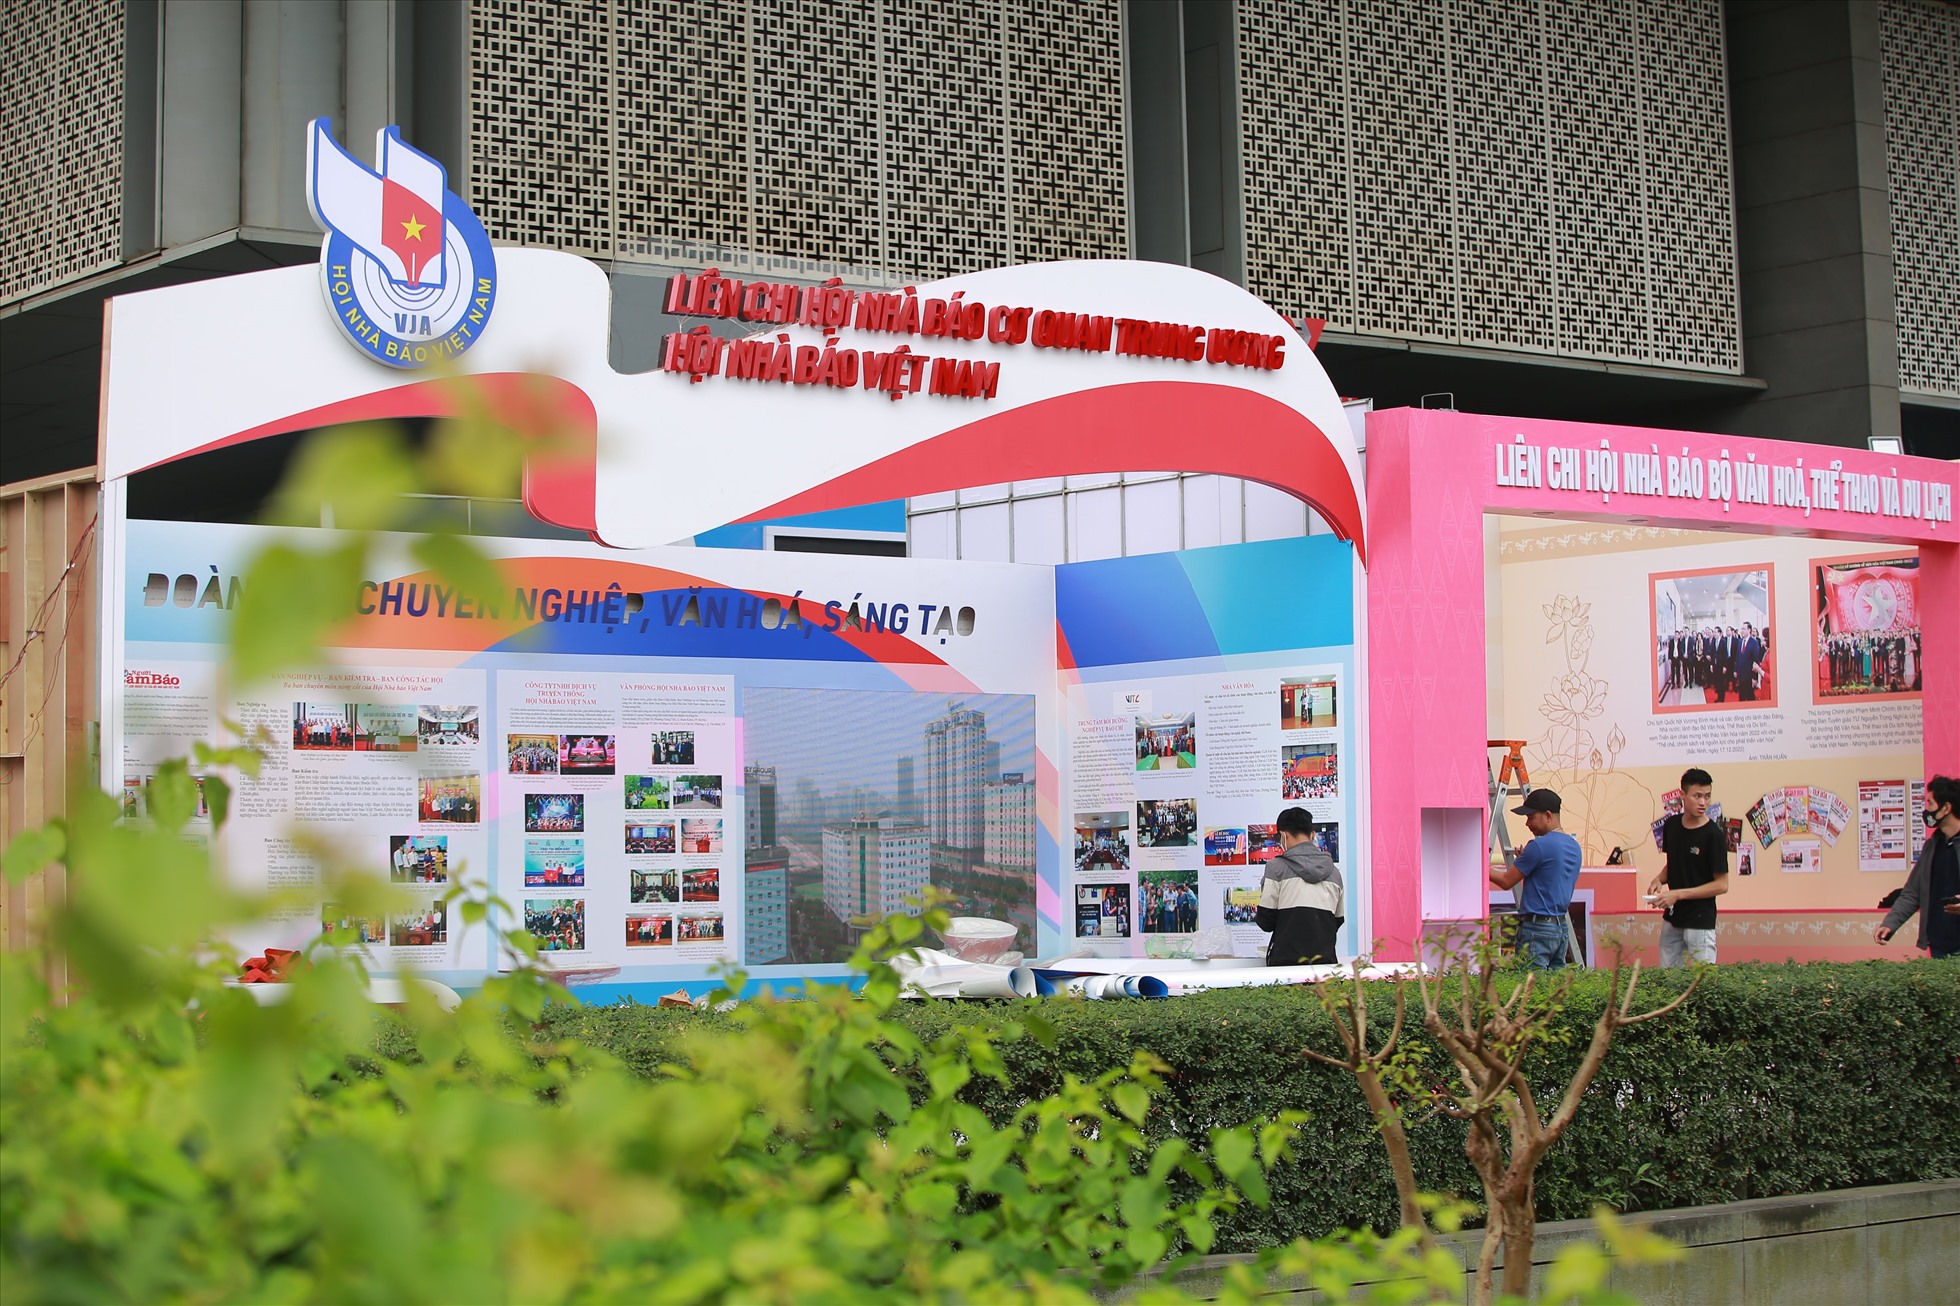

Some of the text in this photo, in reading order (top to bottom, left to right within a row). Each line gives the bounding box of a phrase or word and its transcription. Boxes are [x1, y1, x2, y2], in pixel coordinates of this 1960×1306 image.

[331, 264, 492, 362] HỘI NHÀ BÁO VIỆT NAM
[394, 312, 432, 336] VJA
[666, 267, 1286, 370] LIÊN CHI HỘI NHÀ BÁO CƠ QUAN TRUNG ƯƠNG
[663, 324, 1000, 401] HỘI NHÀ BÁO VIỆT NAM
[1495, 433, 1951, 530] LIÊN CHI HỘI NHÀ BÁO BỘ VĂN HOÁ, THỂ THAO VÀ DU LỊCH
[512, 582, 651, 634] NGHIỆP,
[663, 585, 728, 629] VĂN
[737, 590, 813, 639] HOÁ,
[821, 592, 909, 634] SÁNG
[917, 602, 977, 644] TẠO
[124, 673, 180, 685] àm Báo
[287, 673, 313, 681] NGHIỆP
[313, 674, 323, 682] VỤ
[396, 675, 415, 683] CÔNG
[416, 675, 430, 683] TÁC
[431, 676, 443, 684] HỘI
[587, 683, 597, 691] VỤ
[656, 684, 669, 692] HỘI
